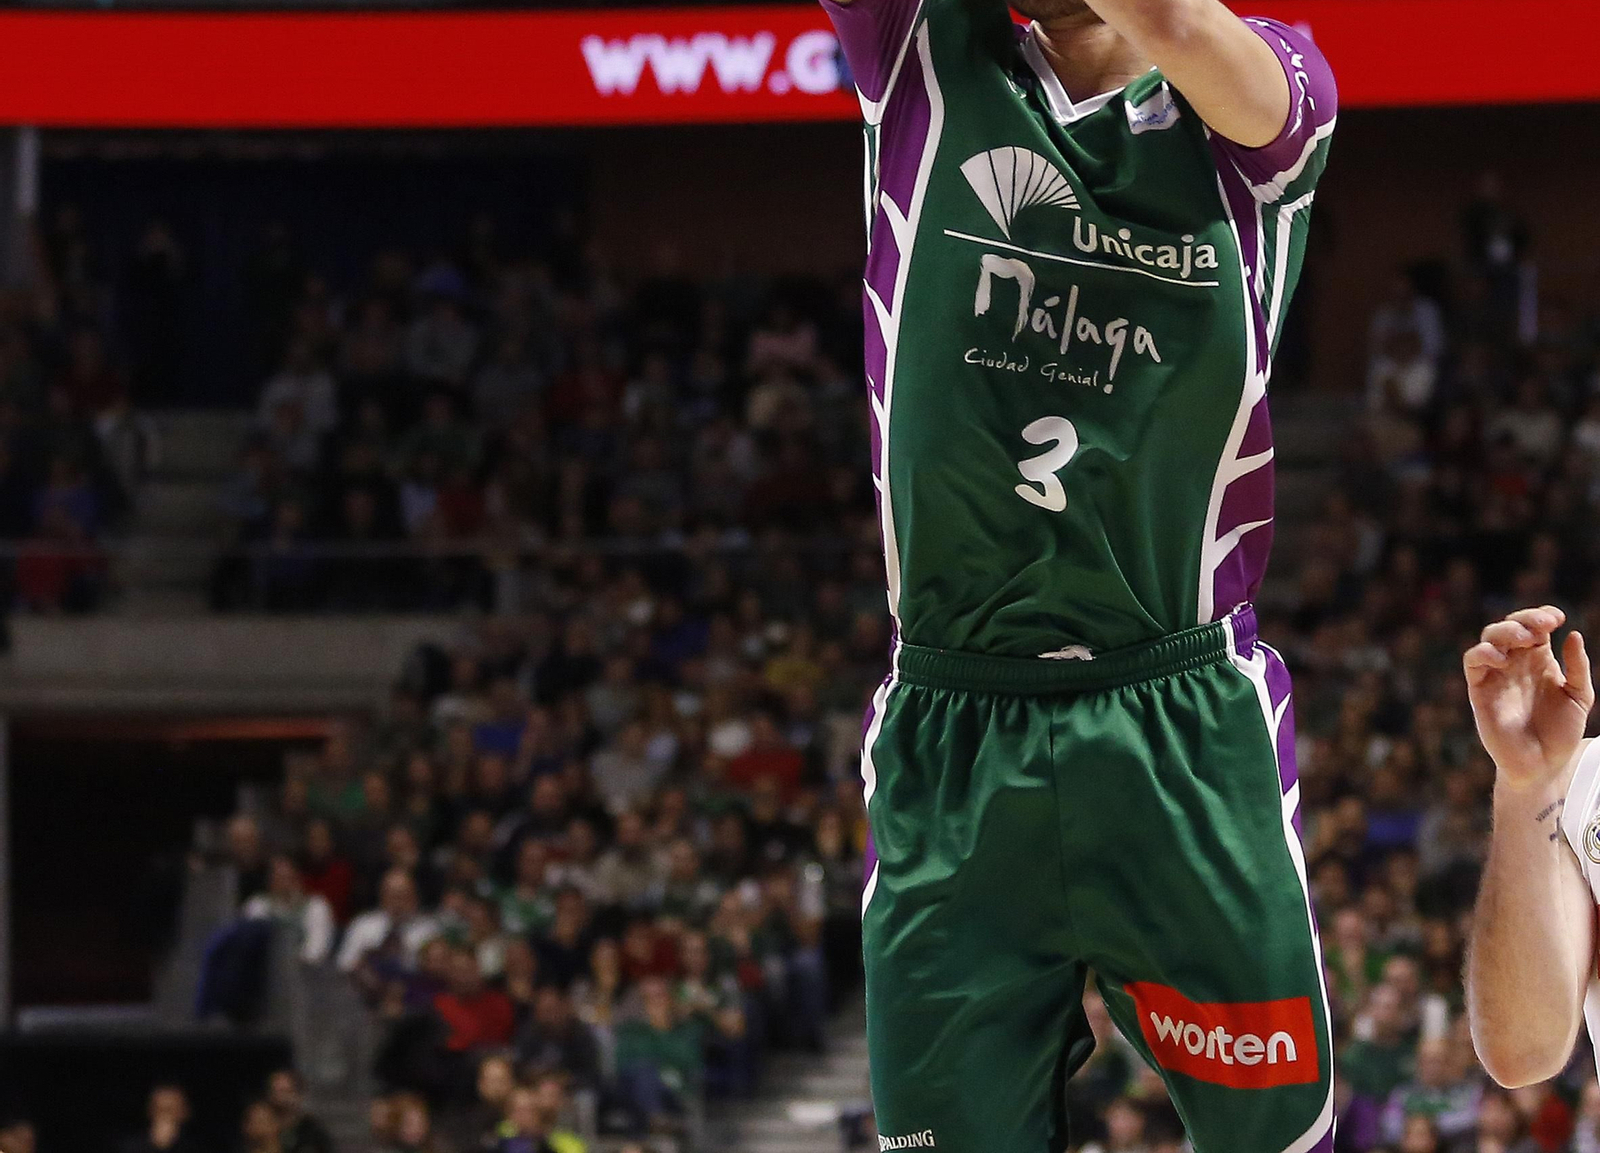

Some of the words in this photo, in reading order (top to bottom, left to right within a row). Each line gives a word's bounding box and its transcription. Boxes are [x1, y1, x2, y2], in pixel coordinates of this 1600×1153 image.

[1073, 215, 1219, 279] Unicaja
[964, 347, 1030, 373] Ciudad
[1014, 415, 1080, 512] 3
[1150, 1011, 1297, 1066] worten
[877, 1129, 936, 1152] PALDING
